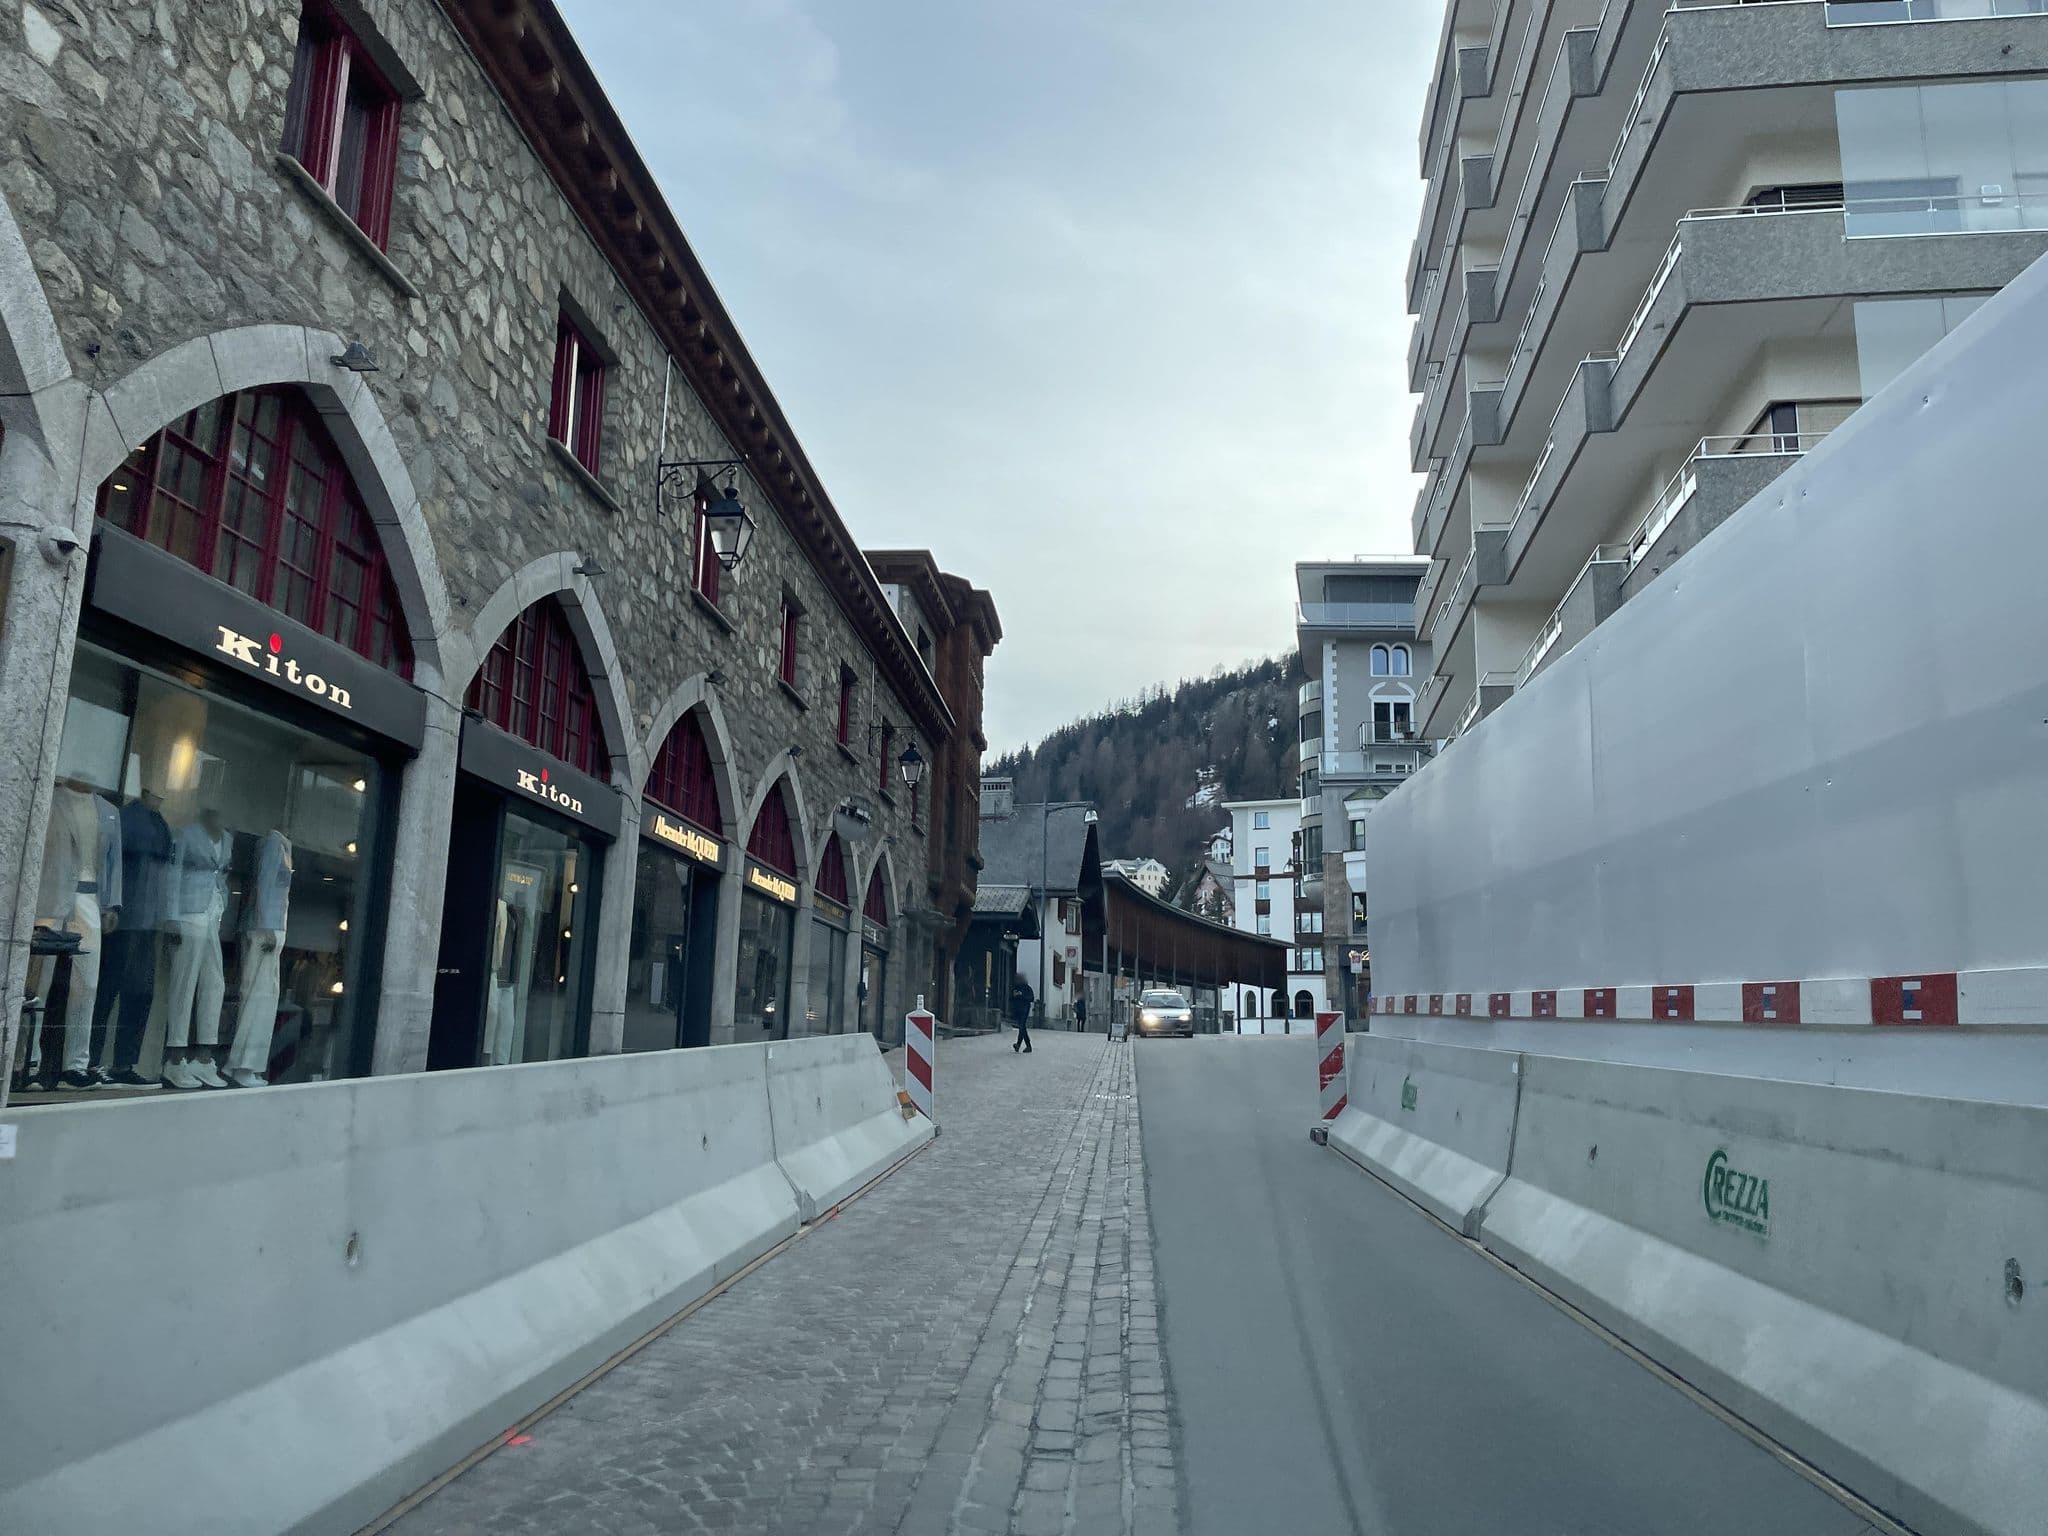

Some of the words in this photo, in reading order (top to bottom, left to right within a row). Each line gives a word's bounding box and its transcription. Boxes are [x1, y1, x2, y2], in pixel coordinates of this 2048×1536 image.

[216, 625, 353, 709] Kiton
[516, 768, 584, 814] Kiton
[1704, 1150, 1769, 1219] CREZZA
